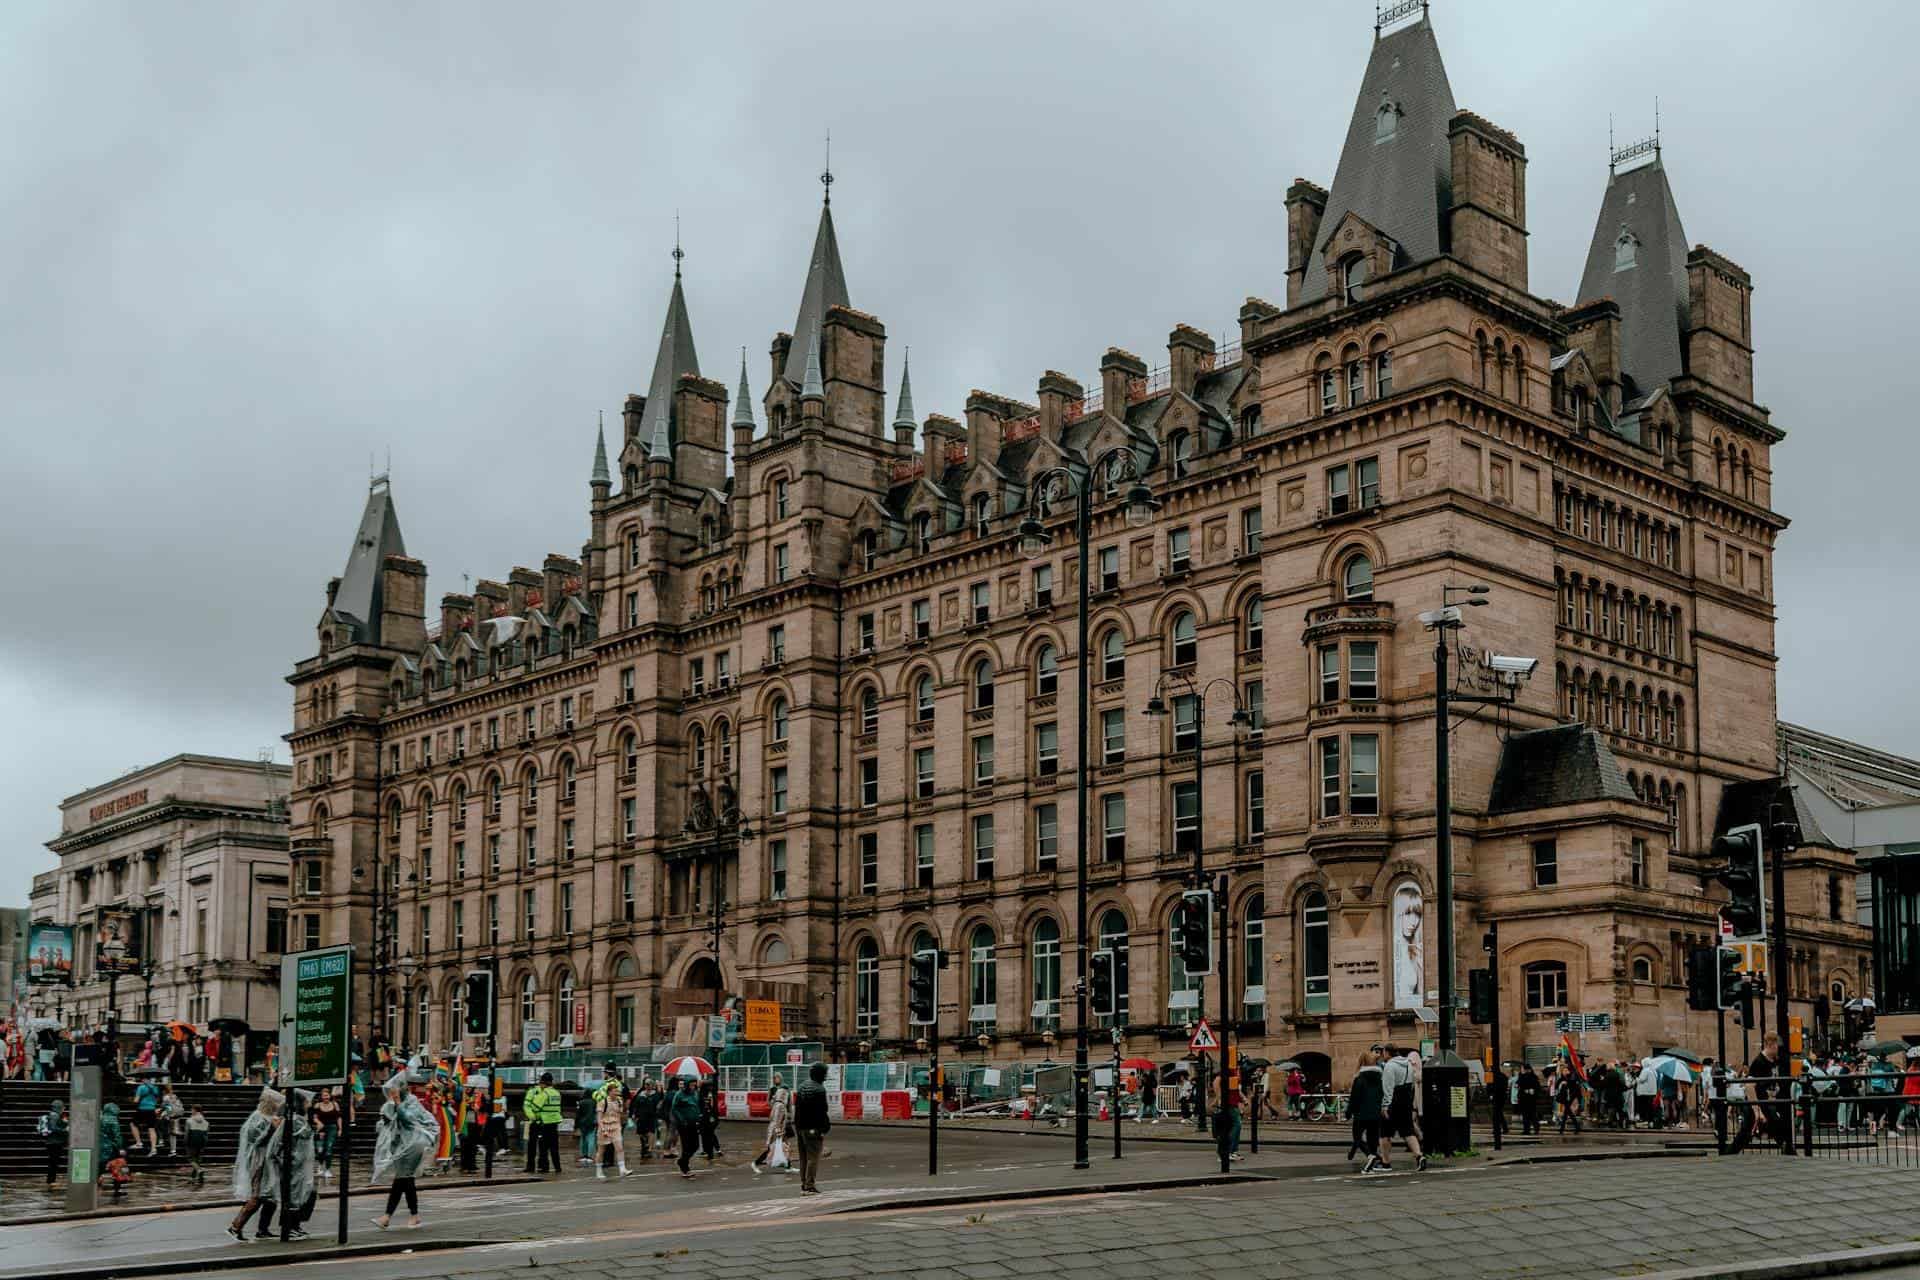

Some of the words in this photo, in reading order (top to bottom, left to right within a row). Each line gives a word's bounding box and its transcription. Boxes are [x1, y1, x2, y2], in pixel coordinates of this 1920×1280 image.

[298, 986, 335, 998] Manchester
[298, 1000, 333, 1014] Warrington
[297, 1032, 332, 1046] Birkenhead
